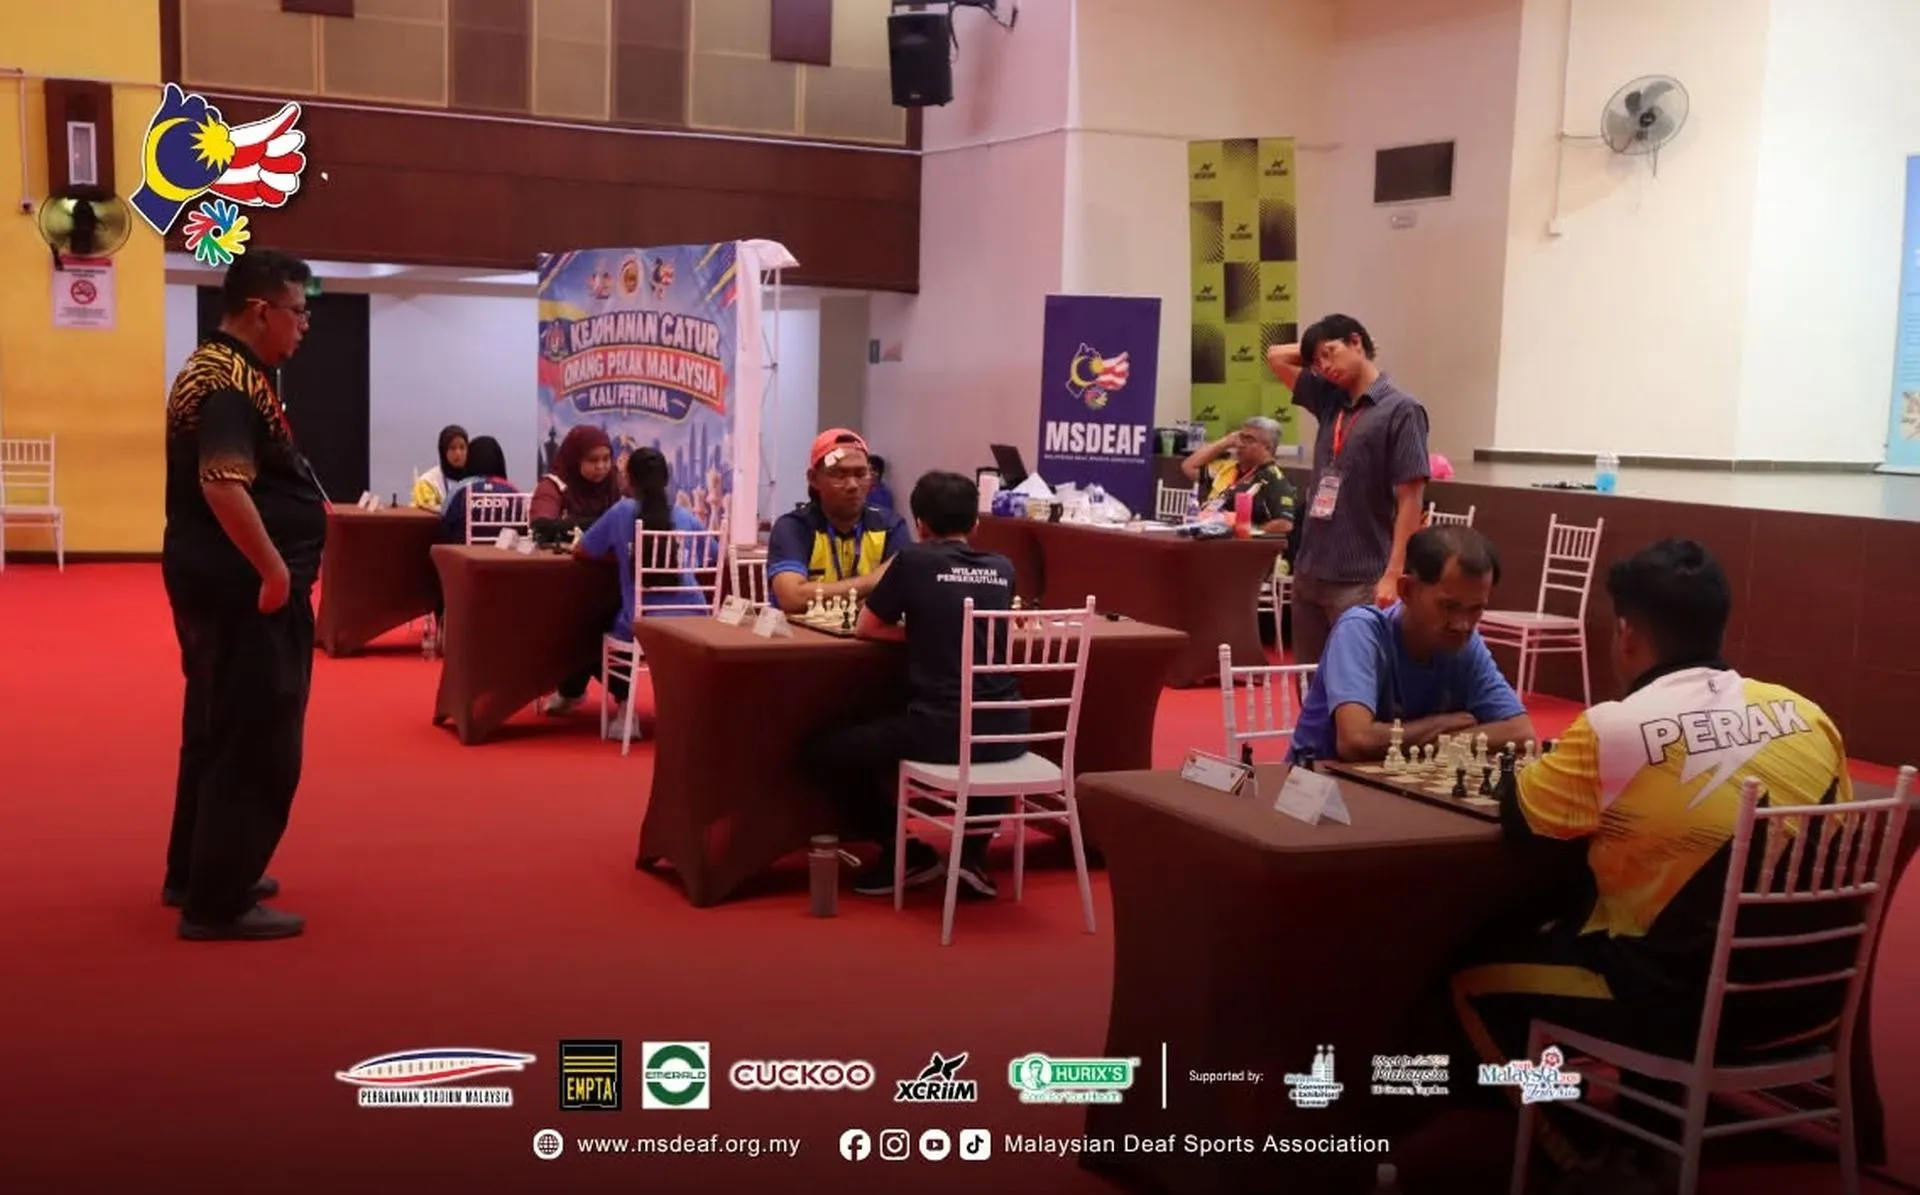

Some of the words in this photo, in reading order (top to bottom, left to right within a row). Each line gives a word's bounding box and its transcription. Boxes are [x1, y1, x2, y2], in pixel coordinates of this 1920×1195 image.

[571, 313, 657, 351] KEJOHANAN
[662, 316, 718, 357] CATUR
[564, 354, 604, 386] ORANG
[608, 354, 643, 374] PEKAK
[648, 355, 717, 397] MALAYSIA
[618, 386, 668, 413] PERTAMA
[1045, 421, 1147, 455] MSDEAF
[951, 567, 997, 576] WILAYAH
[1640, 700, 1811, 765] PERAK
